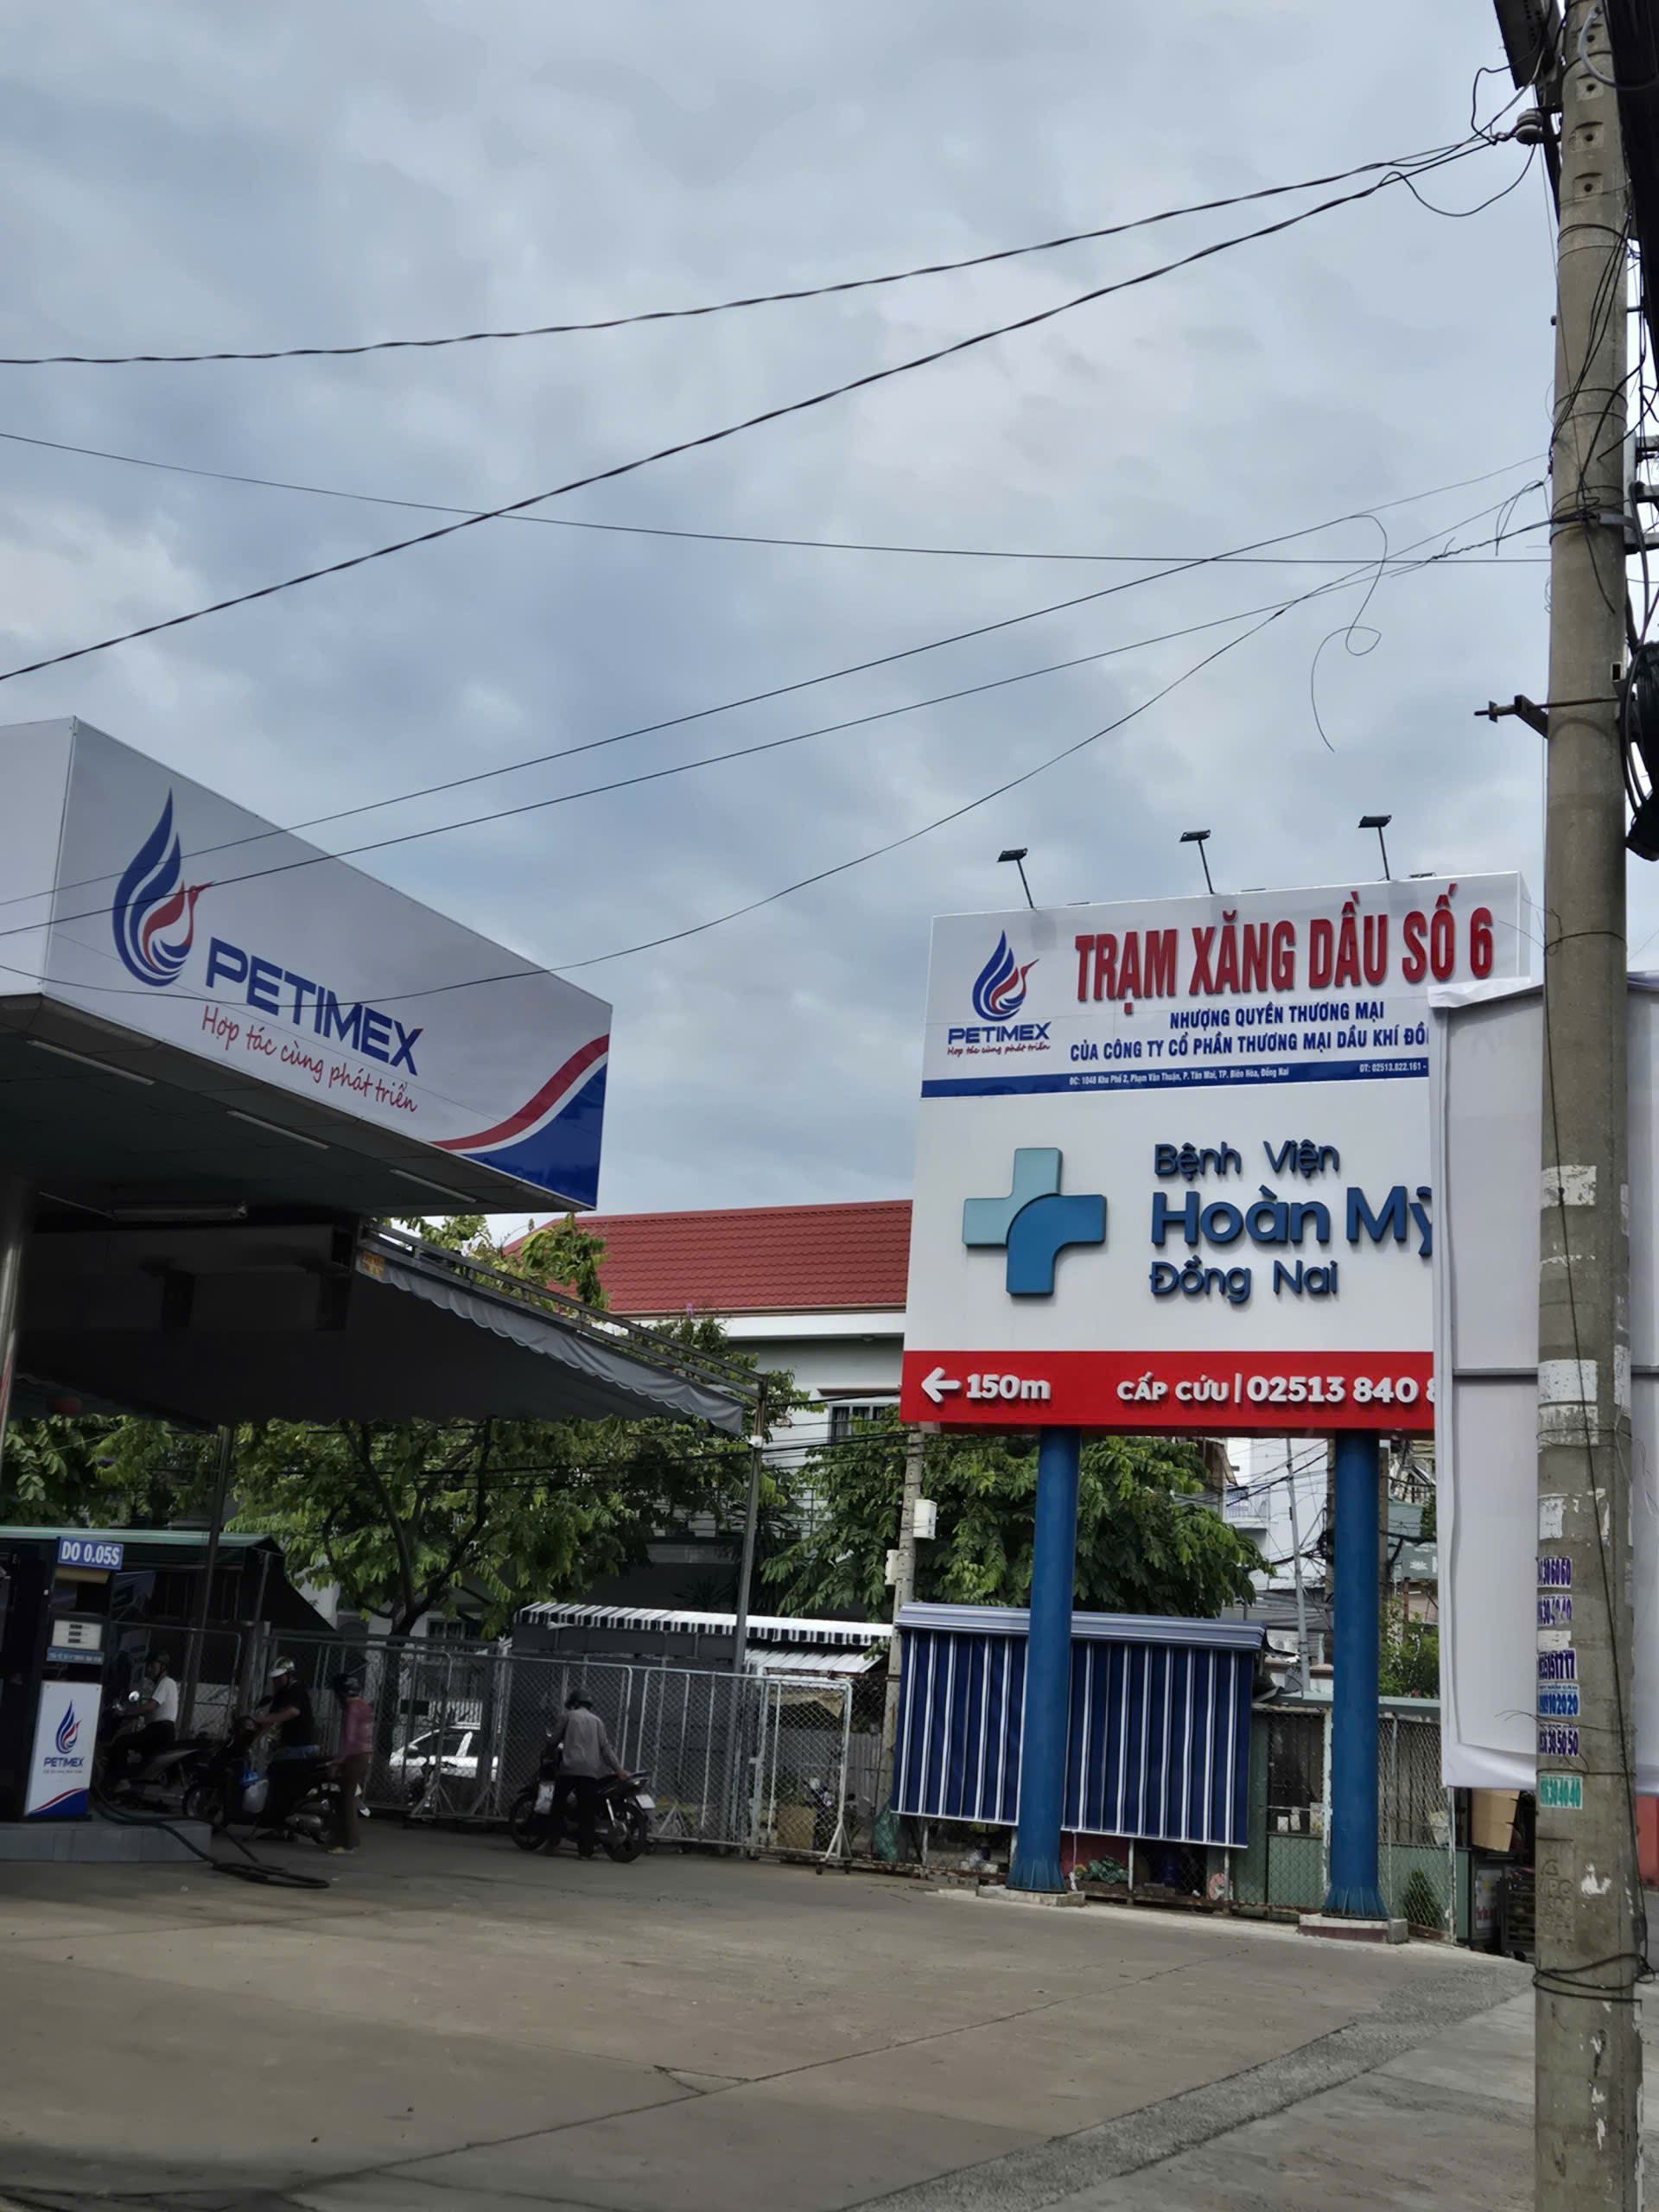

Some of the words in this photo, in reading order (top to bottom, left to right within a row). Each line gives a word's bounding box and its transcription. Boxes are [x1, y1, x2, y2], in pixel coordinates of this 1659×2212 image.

[1075, 929, 1178, 1014] TRẠM
[1189, 909, 1296, 996] XĂNG
[1308, 891, 1388, 988] DẦU
[1402, 883, 1458, 982] SỐ
[1470, 907, 1493, 979] 6
[206, 937, 423, 1077] PETIMEX
[1170, 1008, 1230, 1031] NHƯỢNG
[1236, 1001, 1283, 1027] QUYỀN
[1289, 1001, 1350, 1023] THƯƠNG
[1355, 1001, 1384, 1023] MẠI
[201, 1005, 239, 1051] Hợp
[246, 1025, 277, 1056] tác
[280, 1040, 324, 1084] cùng
[328, 1062, 373, 1096] phát
[948, 1021, 1052, 1045] PETIMEX
[1071, 1039, 1098, 1061] CỦA
[1103, 1038, 1141, 1059] CÔNG
[1147, 1039, 1164, 1057] TY
[1168, 1032, 1188, 1056] CỔ
[1193, 1031, 1232, 1055] PHẦN
[1237, 1032, 1297, 1052] THƯƠNG
[1303, 1032, 1332, 1053] MẠI
[1338, 1024, 1367, 1048] DẦU
[1373, 1024, 1400, 1046] KHÍ
[1403, 1021, 1429, 1046] ĐỒ
[1154, 1141, 1242, 1181] Bệnh
[1262, 1139, 1339, 1179] Viện
[1151, 1184, 1331, 1246] Hoàn
[1149, 1255, 1252, 1304] Đồng
[1273, 1259, 1338, 1294] Nai
[966, 1374, 1051, 1399] 150m
[1117, 1371, 1168, 1401] CẤP
[1247, 1376, 1345, 1402] 02513
[1353, 1376, 1419, 1403] 840
